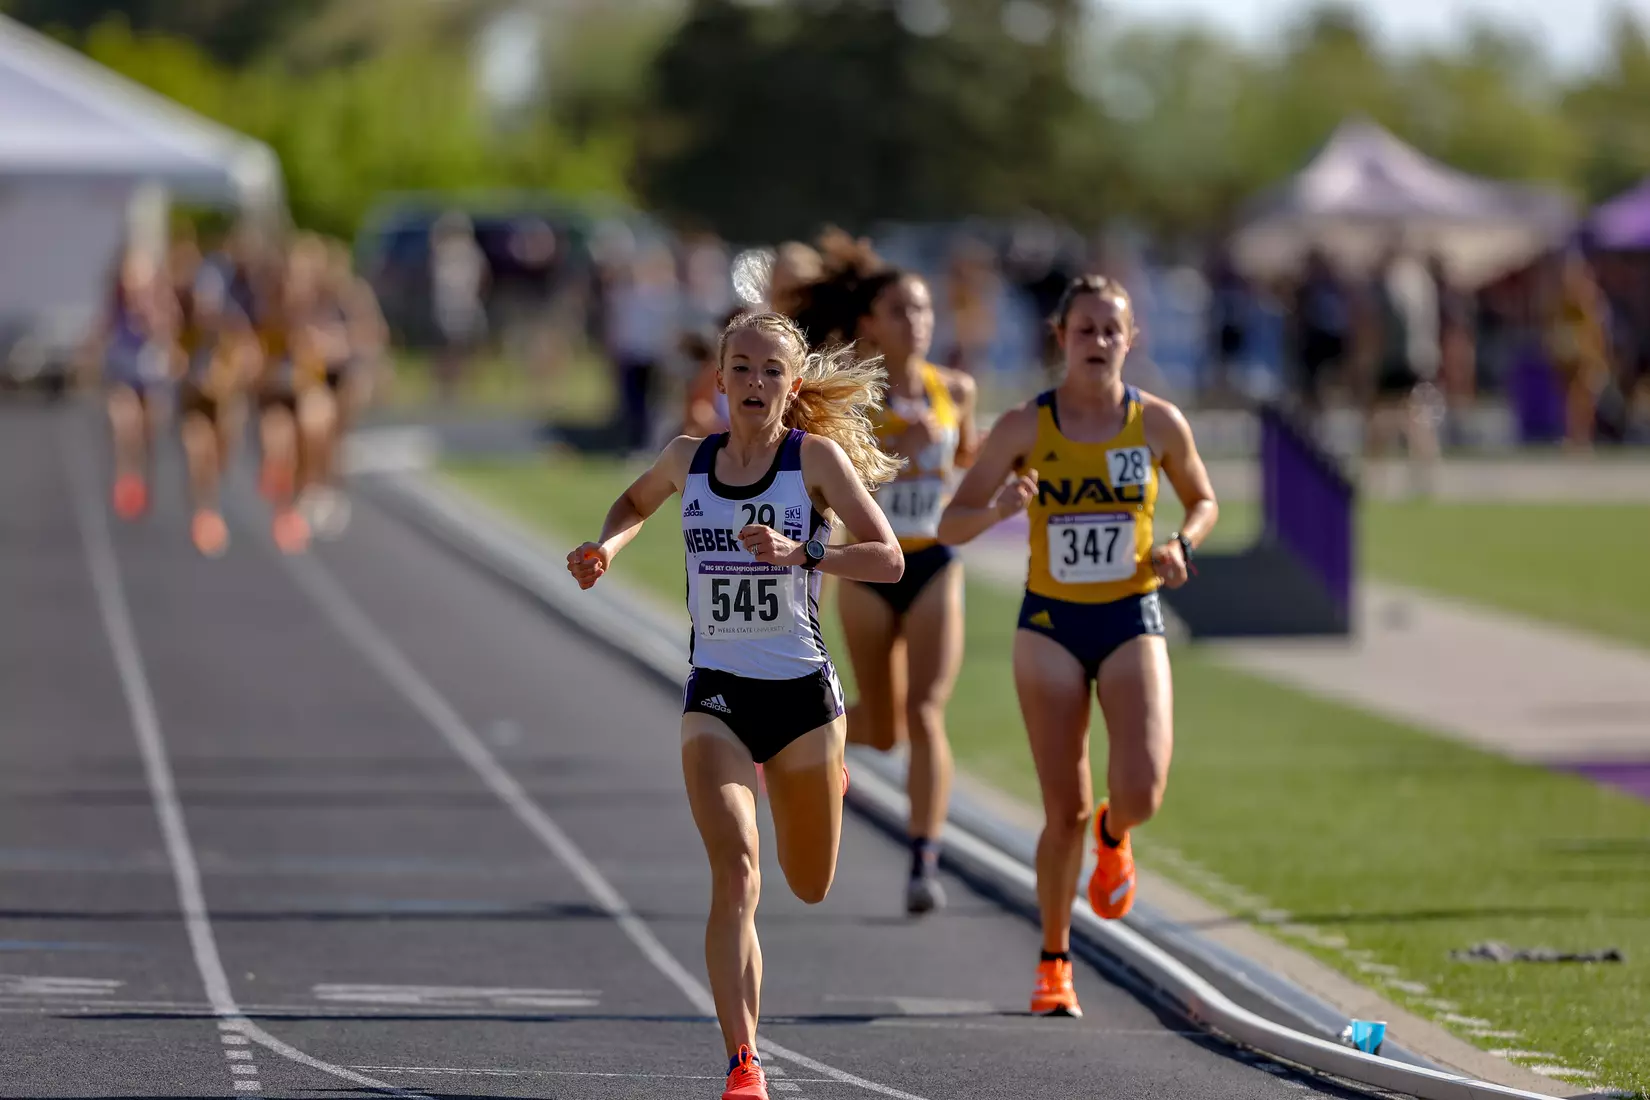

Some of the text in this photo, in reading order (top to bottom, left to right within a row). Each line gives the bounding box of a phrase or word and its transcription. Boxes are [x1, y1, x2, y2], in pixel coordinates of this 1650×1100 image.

[1115, 450, 1145, 482] 28
[1038, 477, 1145, 505] NAU
[742, 503, 776, 529] 29
[785, 508, 801, 519] SKY
[684, 528, 741, 553] WEBER
[1062, 527, 1121, 565] 347
[711, 578, 779, 622] 545
[700, 700, 732, 714] adidas
